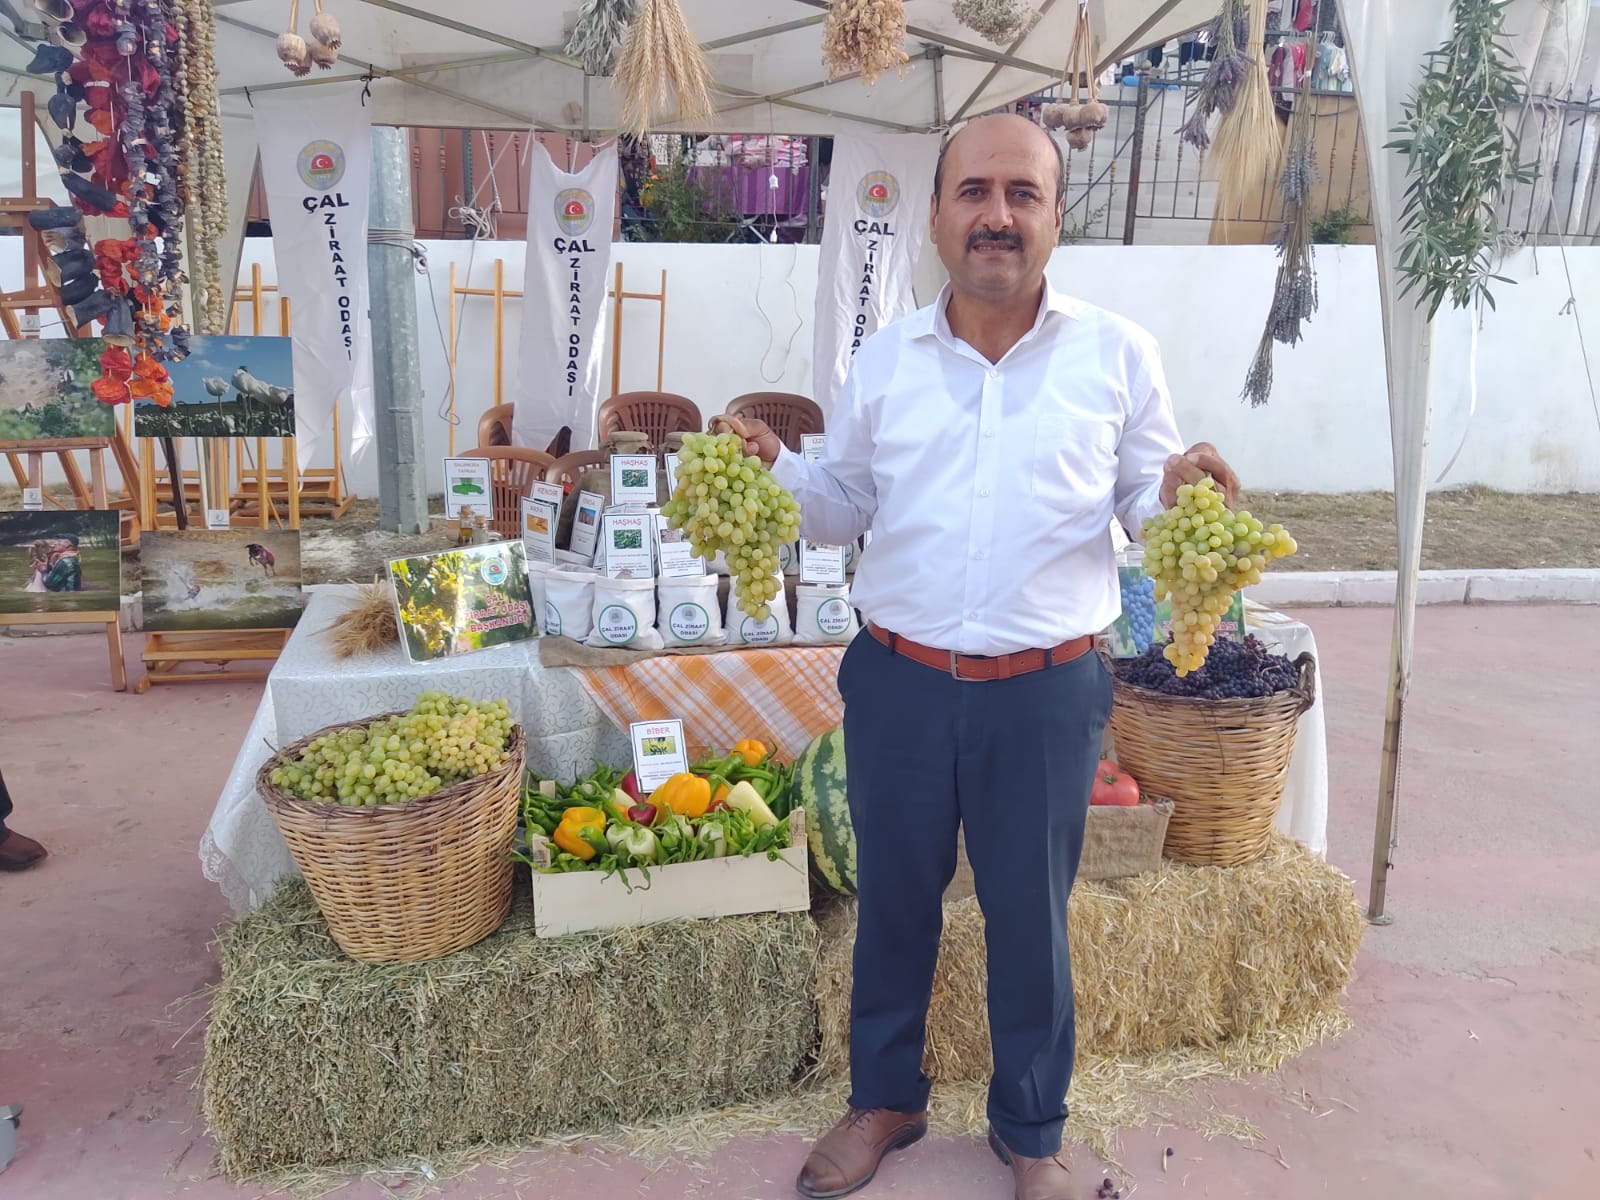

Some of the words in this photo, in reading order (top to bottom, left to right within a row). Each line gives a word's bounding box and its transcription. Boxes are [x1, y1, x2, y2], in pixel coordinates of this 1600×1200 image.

[302, 193, 350, 214] ÇAL
[855, 219, 895, 237] ÇAL
[554, 237, 596, 254] ÇAL
[858, 239, 878, 307] ZİRAAT
[323, 213, 348, 288] ZİRAAT
[337, 295, 353, 361] ODASI
[569, 258, 582, 326] ZİRAAT
[566, 333, 581, 397] ODASI
[501, 600, 529, 613] ODASI
[646, 726, 670, 736] BİBER
